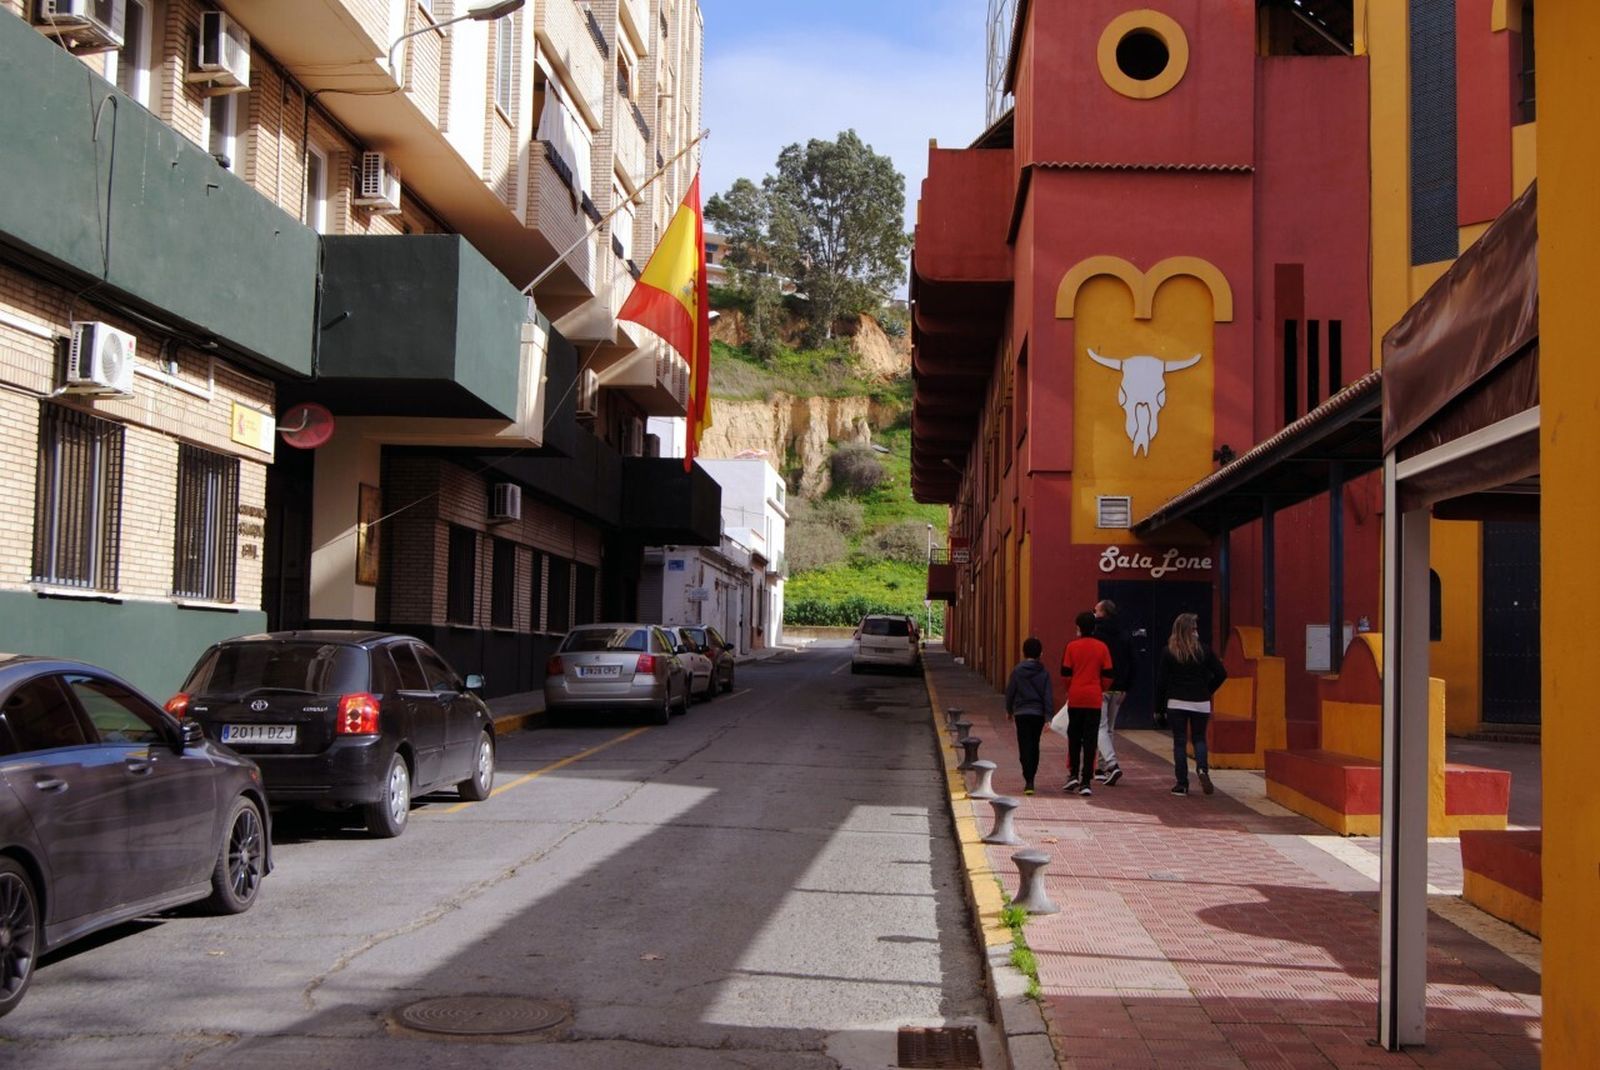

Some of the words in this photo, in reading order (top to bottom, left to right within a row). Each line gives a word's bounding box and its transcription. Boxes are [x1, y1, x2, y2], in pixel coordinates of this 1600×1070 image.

[1099, 545, 1153, 573] Sala
[230, 726, 263, 740] 2011
[268, 726, 295, 740] DZJ
